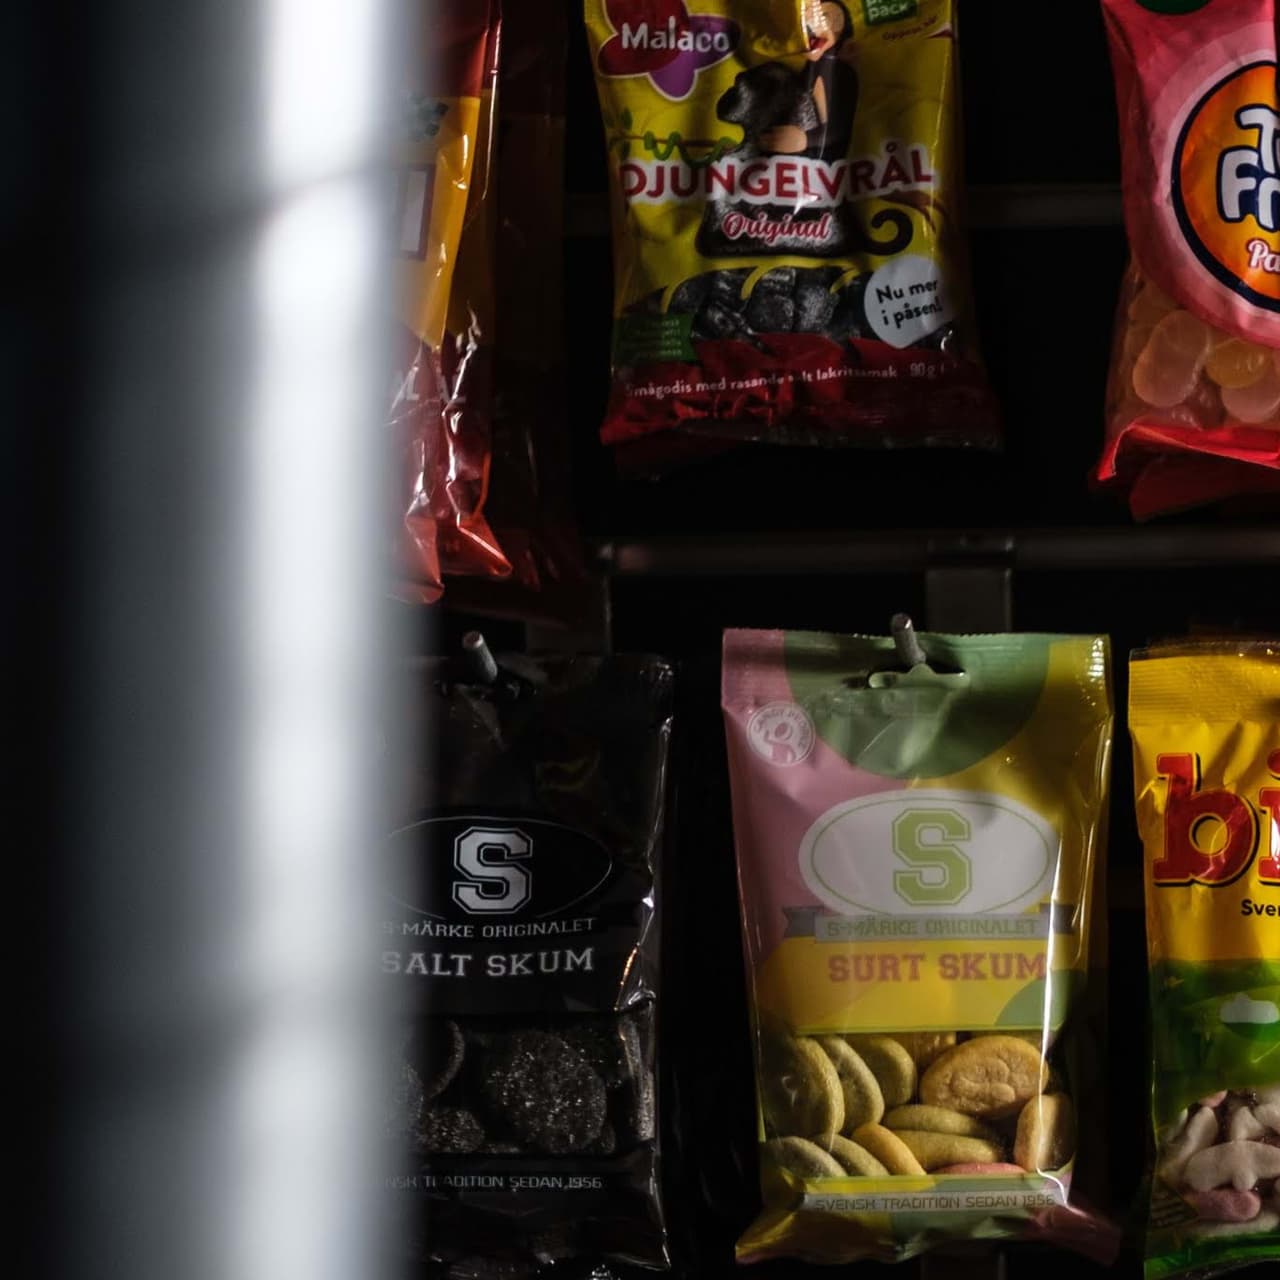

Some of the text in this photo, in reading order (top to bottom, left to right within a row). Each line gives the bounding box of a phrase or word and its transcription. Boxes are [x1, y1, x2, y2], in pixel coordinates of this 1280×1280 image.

[622, 16, 730, 53] Malaco
[619, 141, 931, 198] DJUNGELVRÅL
[721, 211, 831, 243] Original
[876, 280, 938, 303] Nu mer
[894, 302, 942, 329] påsen!
[696, 377, 727, 392] med
[452, 826, 533, 914] S
[892, 809, 972, 905] S
[482, 917, 598, 939] ORIGINALET
[925, 918, 1039, 936] ORIGINALET
[383, 947, 595, 977] SALT SKUM
[828, 952, 1047, 983] SURT SKUM
[509, 1175, 562, 1189] SEDAN
[884, 1195, 1018, 1210] TRADITION SEDAN
